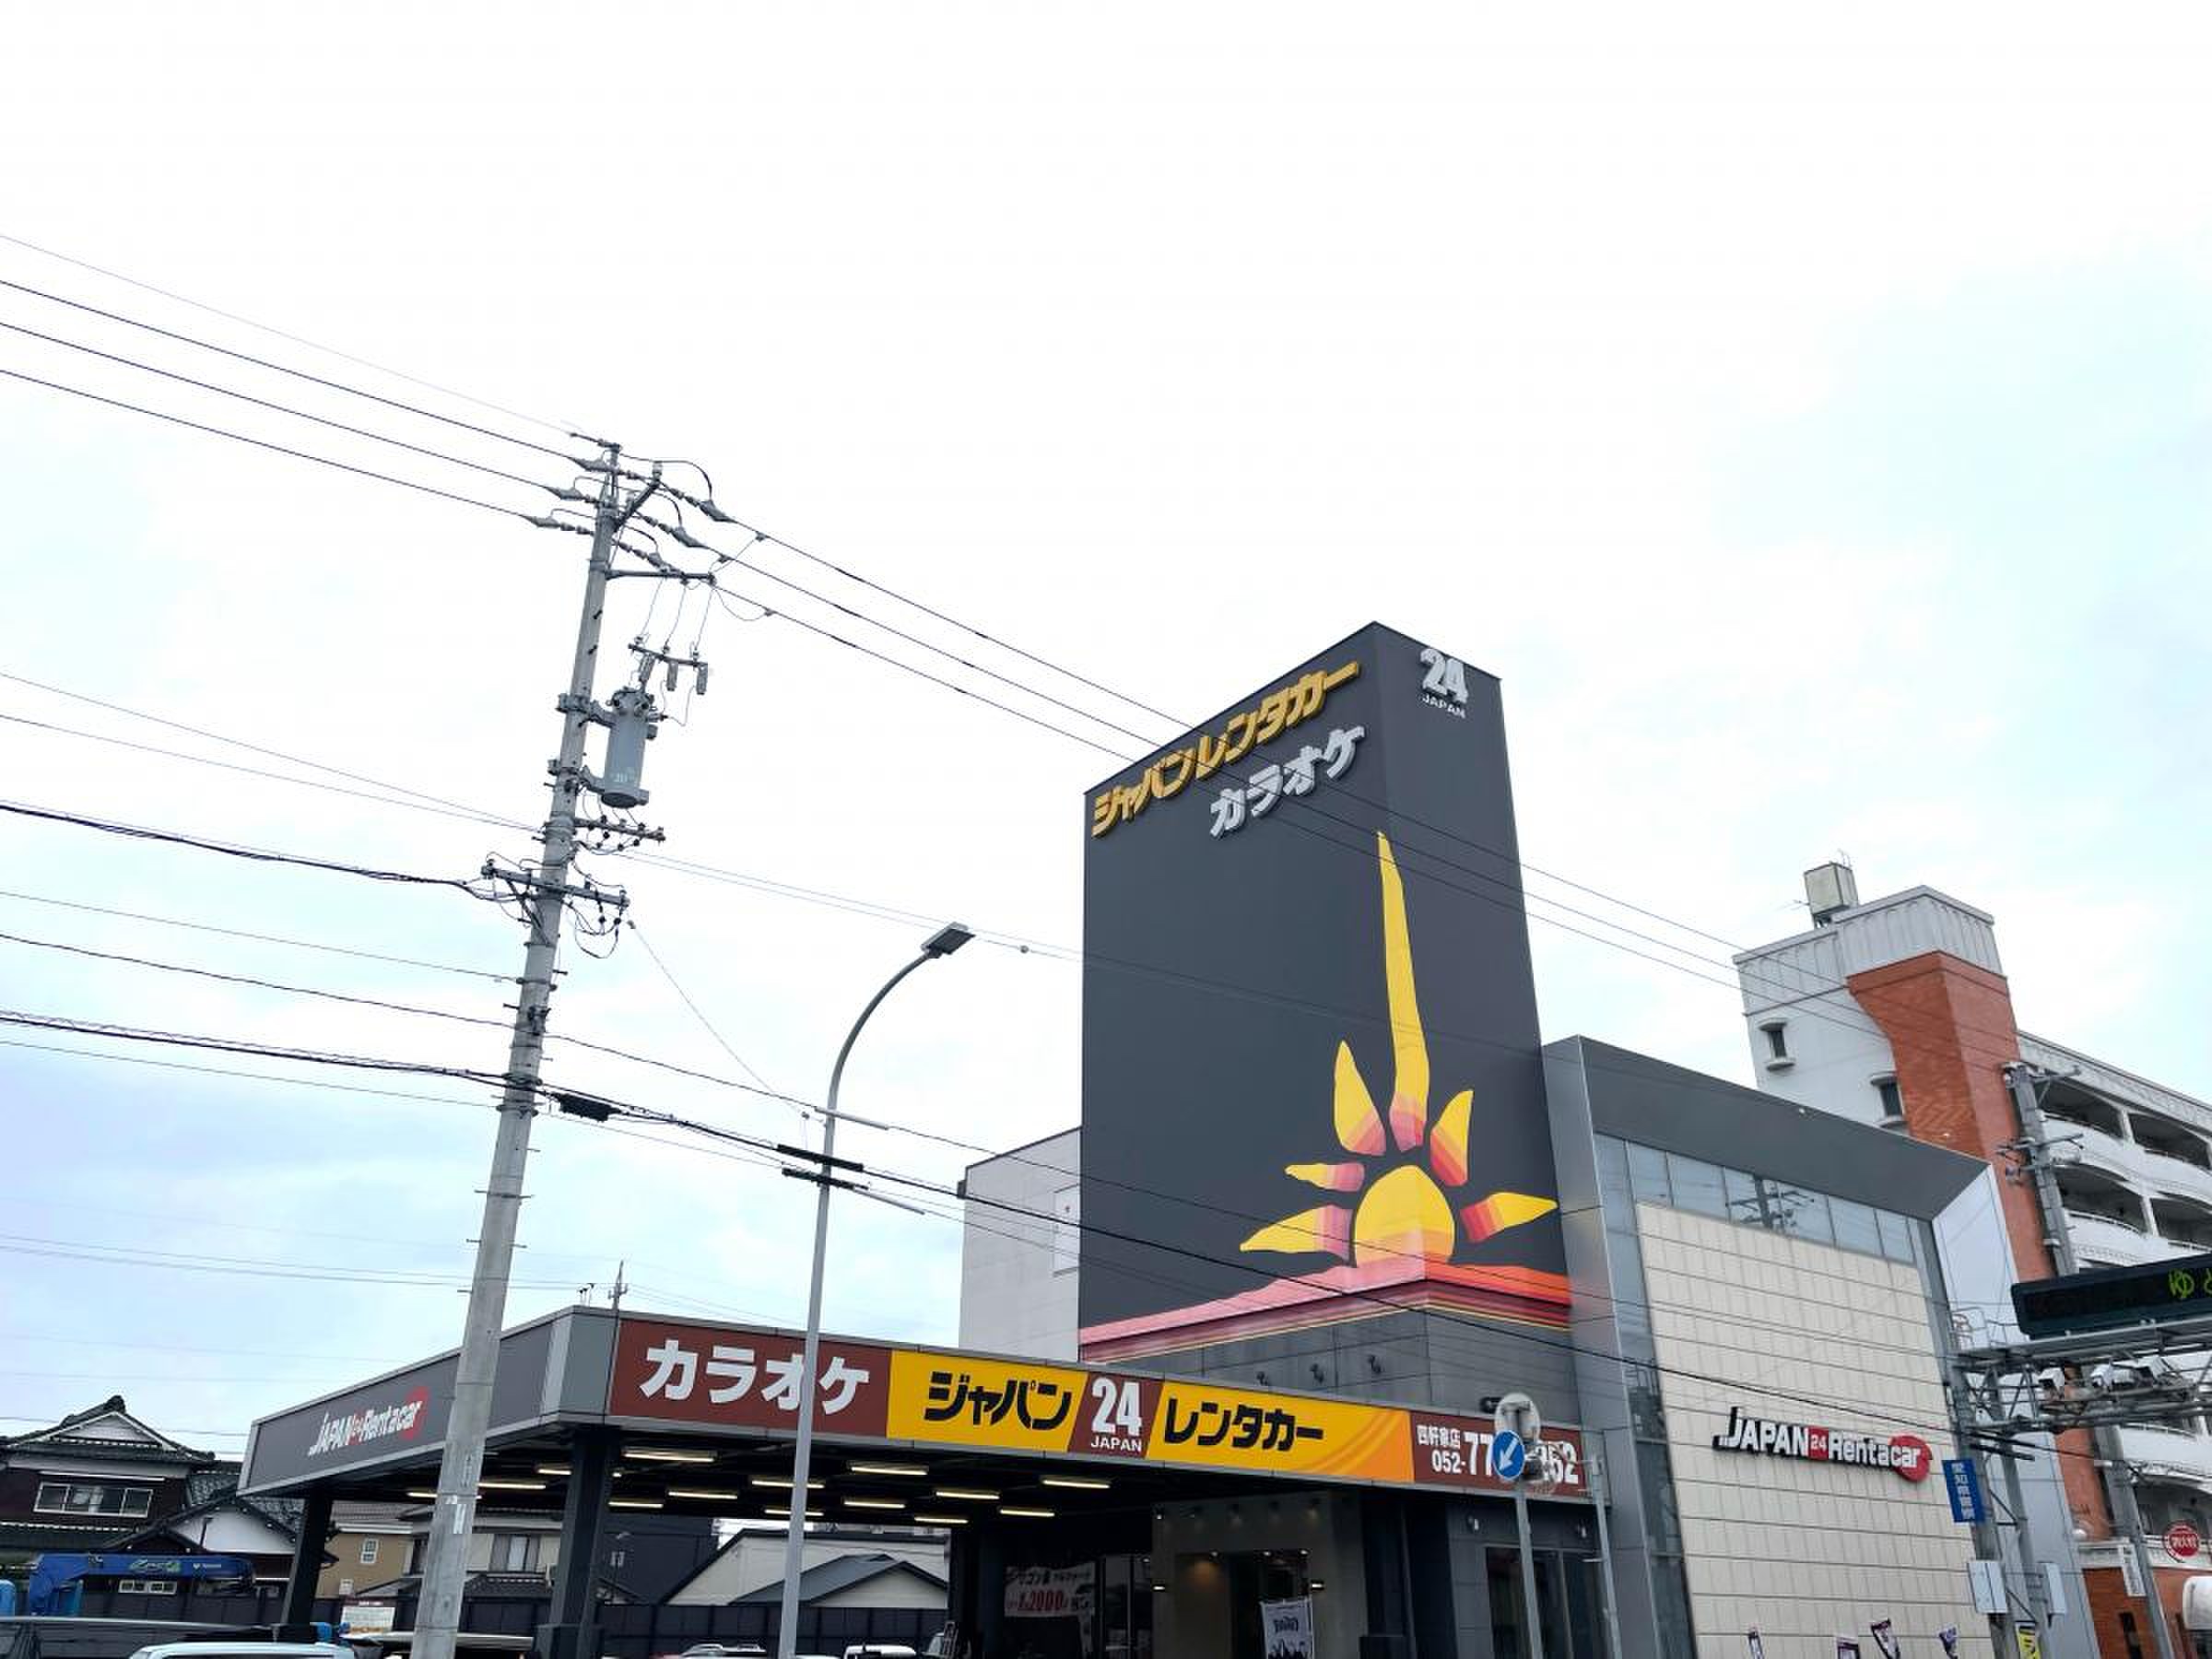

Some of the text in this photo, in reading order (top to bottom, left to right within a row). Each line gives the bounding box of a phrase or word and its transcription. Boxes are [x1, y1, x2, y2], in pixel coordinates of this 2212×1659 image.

[1420, 648, 1469, 704] 24
[1422, 693, 1466, 719] JAPAN
[1092, 661, 1359, 838] ジャパンレンタカー
[1209, 725, 1366, 839] カラオケ
[640, 1339, 870, 1416] カラオケ
[924, 1371, 1072, 1430] ジャパン
[1091, 1377, 1144, 1437] 24
[1090, 1434, 1143, 1453] JAPAN
[1164, 1397, 1324, 1452] レンタカー
